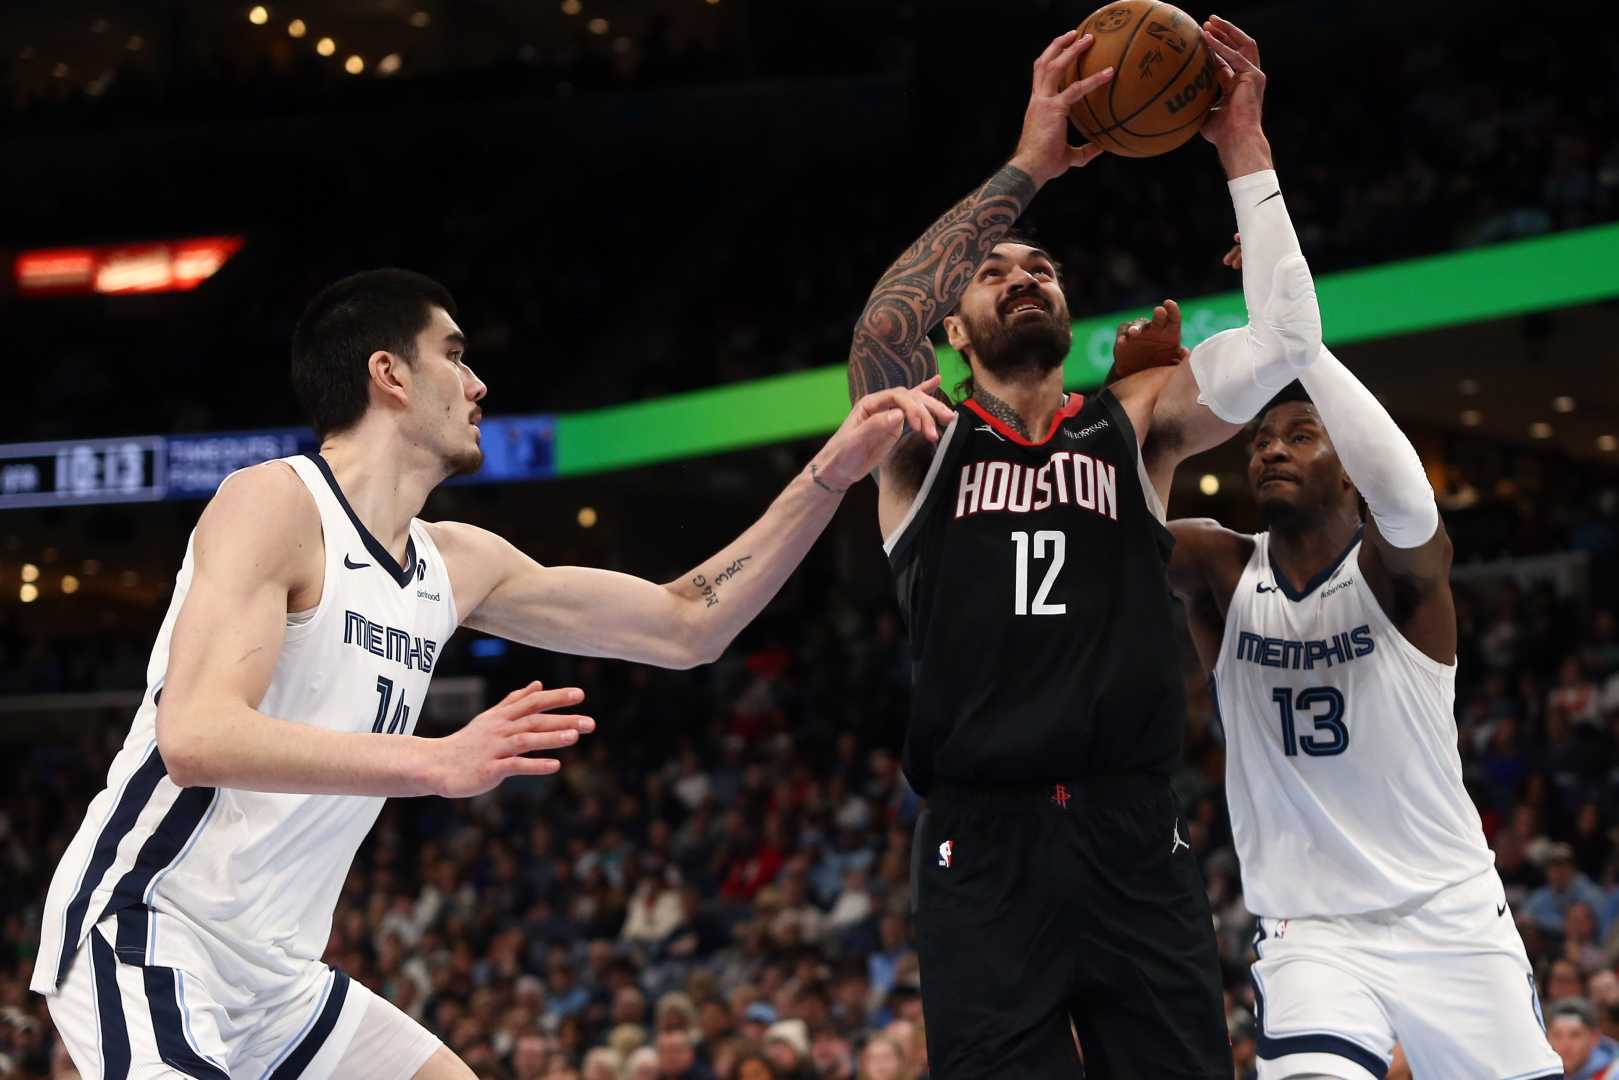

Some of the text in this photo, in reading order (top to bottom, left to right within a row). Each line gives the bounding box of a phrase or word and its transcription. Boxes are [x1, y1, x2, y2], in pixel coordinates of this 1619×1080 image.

[953, 450, 1119, 522] HOUSTON
[1011, 530, 1066, 615] 12
[1236, 624, 1375, 670] MEMPHIS
[371, 674, 410, 734] 14
[1272, 686, 1350, 757] 13
